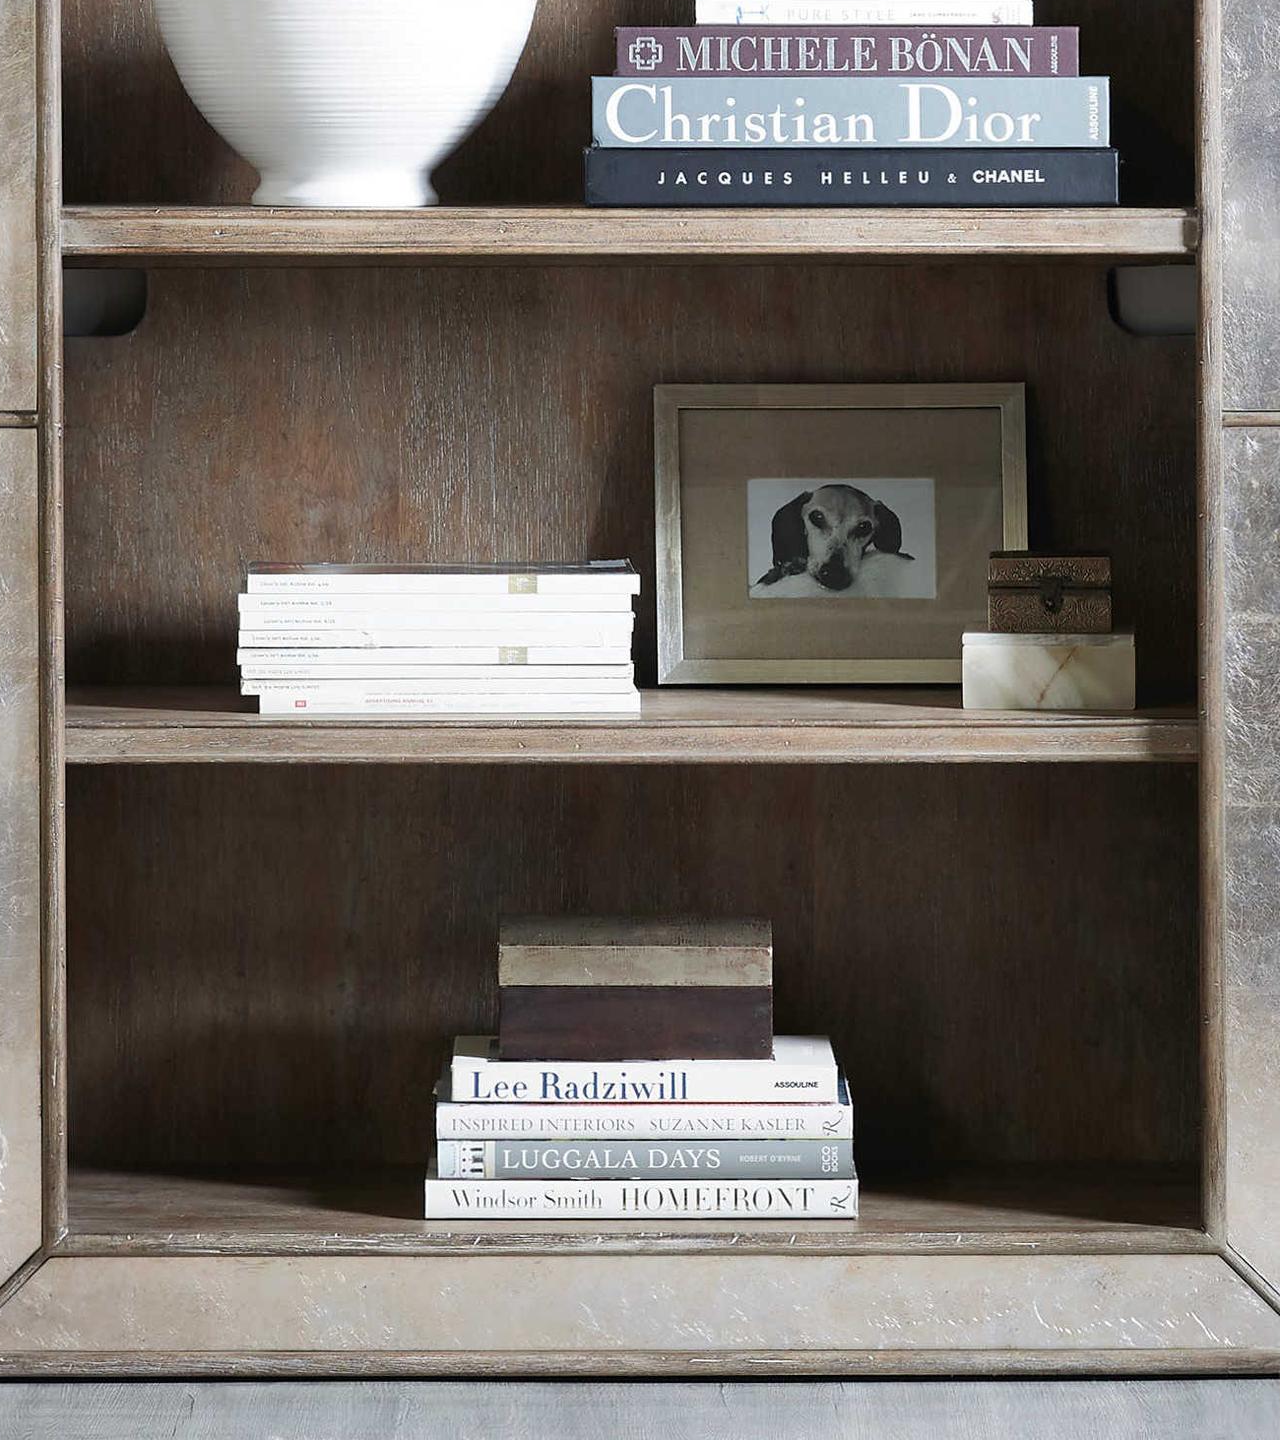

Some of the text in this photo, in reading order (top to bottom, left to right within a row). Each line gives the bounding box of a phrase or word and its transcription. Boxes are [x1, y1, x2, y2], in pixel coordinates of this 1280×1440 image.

[786, 8, 832, 22] PURE
[841, 8, 896, 22] STYLE
[676, 33, 1034, 72] MICHELE BÖNAN
[605, 83, 1041, 144] Christian Dior
[657, 169, 1045, 187] JACQUES HELLEU & CHANEL
[473, 1071, 688, 1100] Lee Radziwill
[774, 1081, 818, 1089] ASSOULINE
[452, 1118, 806, 1131] INSPIRED INTERIORS SUZANNE KASLER
[503, 1150, 720, 1170] LUGGALA DAYS
[821, 1145, 831, 1172] CICO
[831, 1146, 839, 1172] BOOKS
[452, 1187, 814, 1212] Windsor Smith HOMEFRONT
